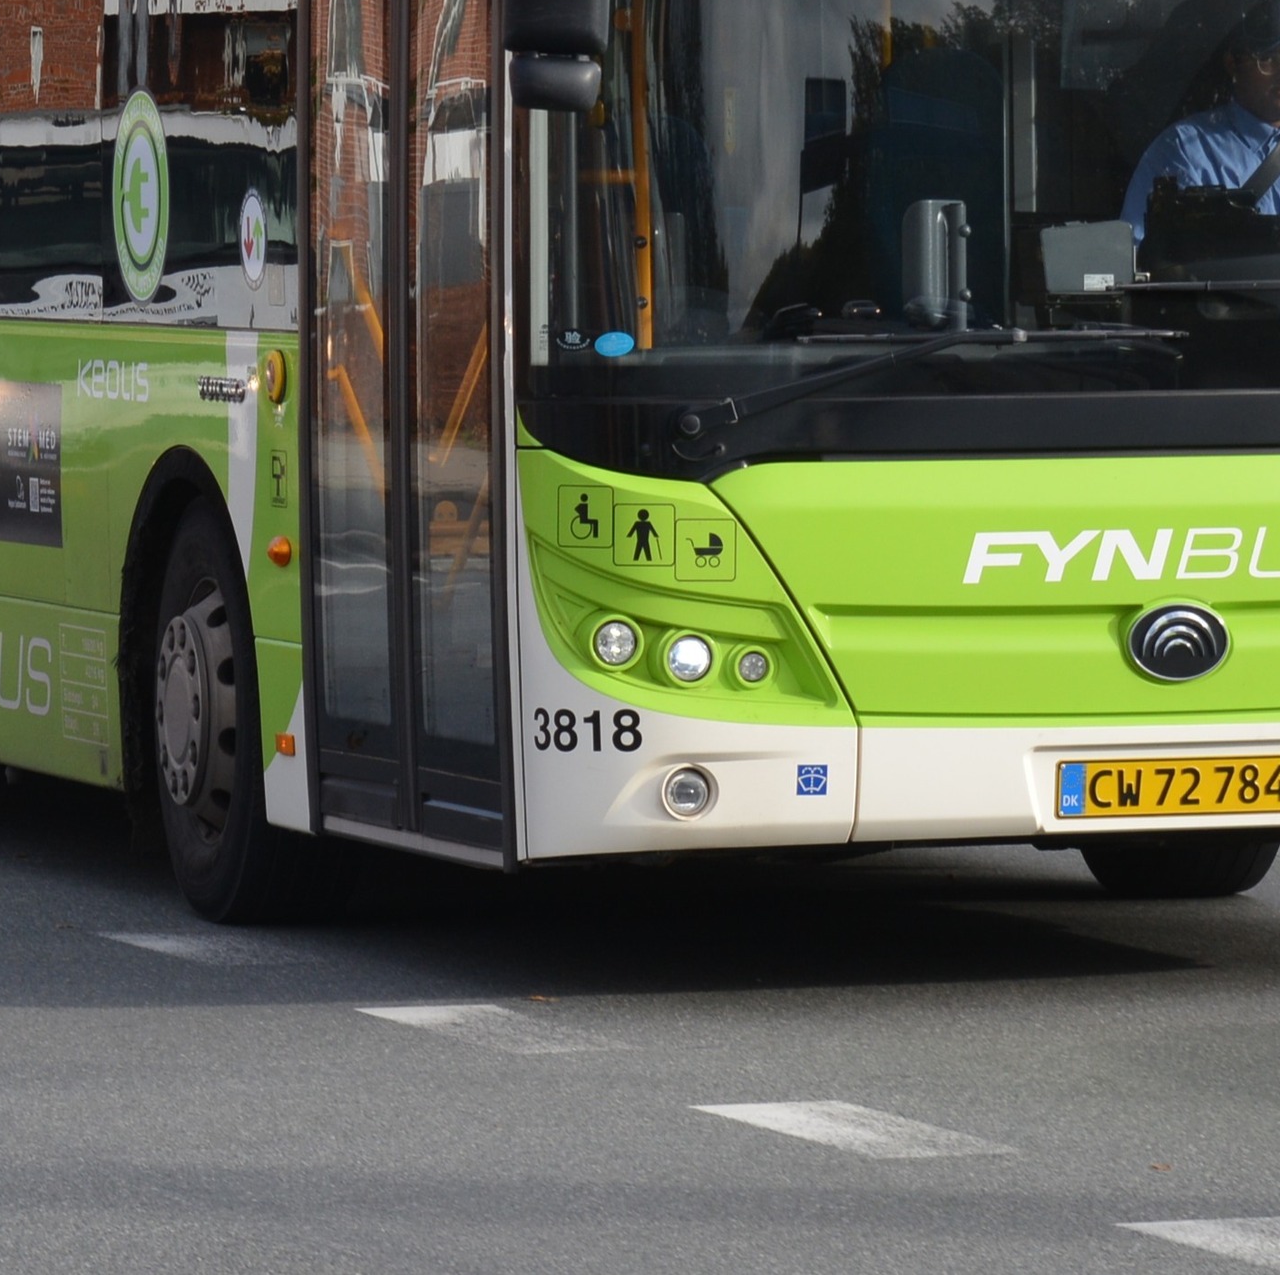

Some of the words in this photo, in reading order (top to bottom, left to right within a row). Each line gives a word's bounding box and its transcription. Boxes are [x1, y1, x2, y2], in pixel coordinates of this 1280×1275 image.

[7, 428, 29, 448] STEM
[533, 707, 643, 752] 3818
[1062, 794, 1079, 807] DK
[1088, 769, 1143, 808] CW
[1154, 767, 1201, 806] 72
